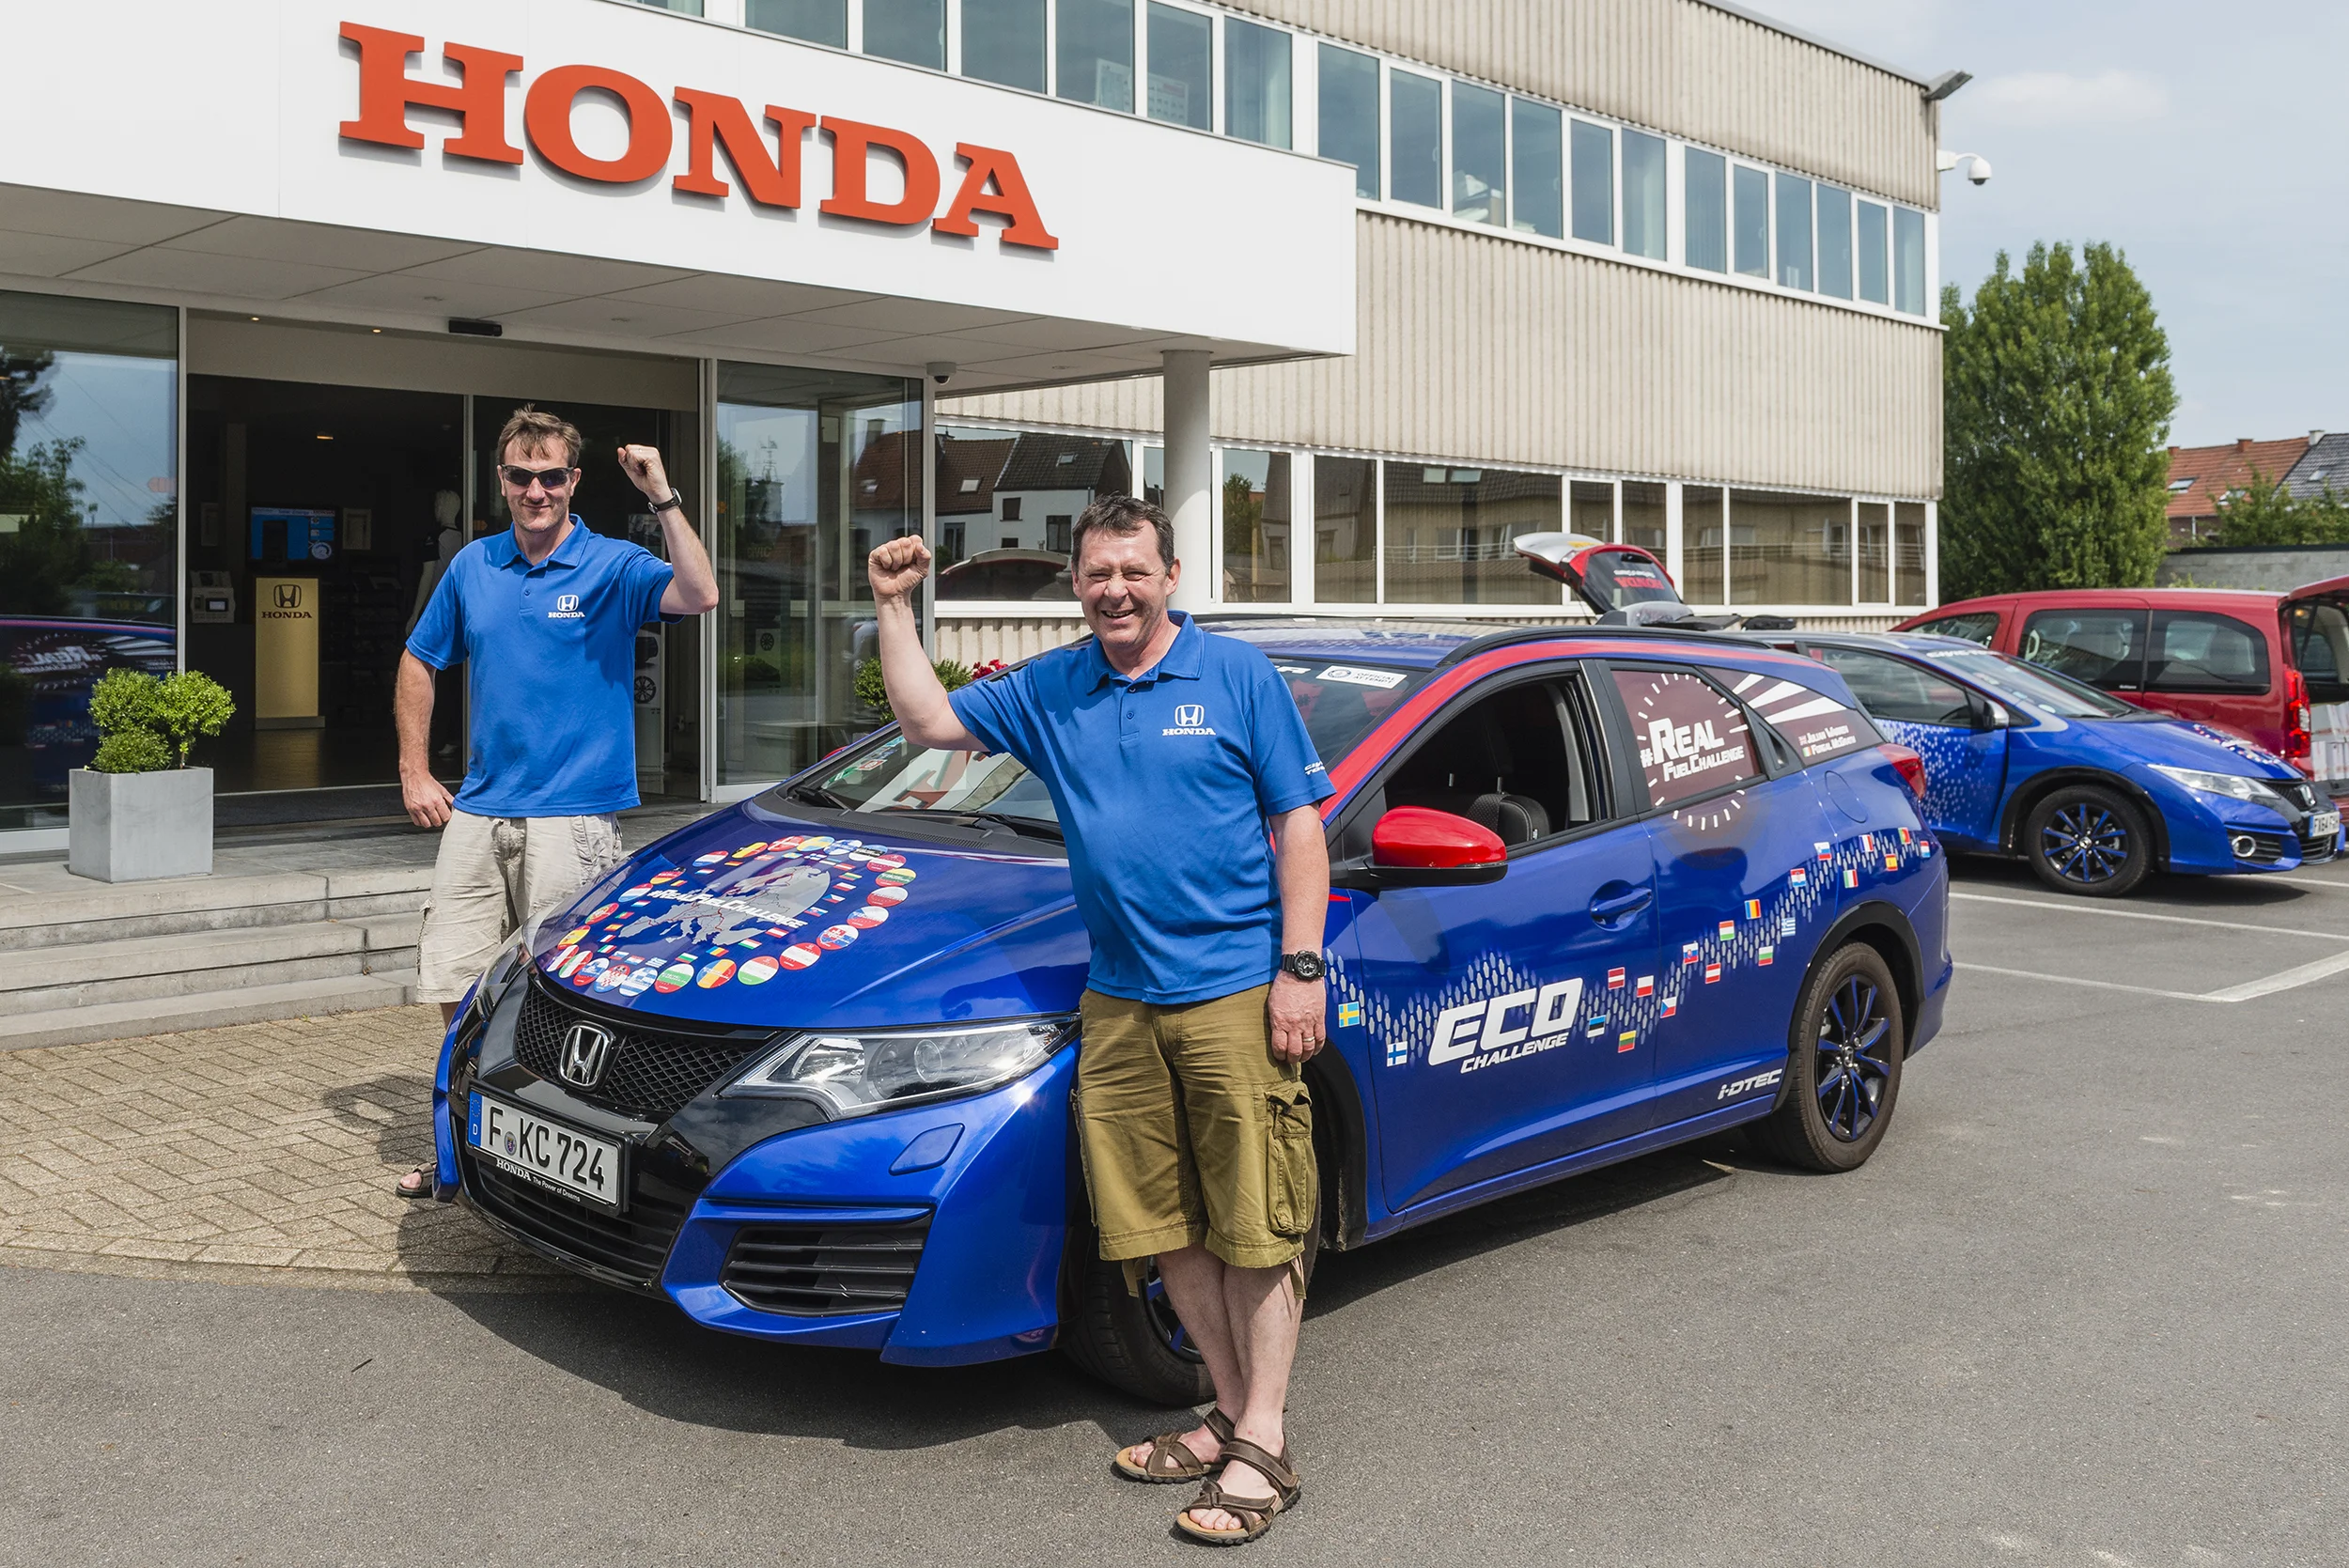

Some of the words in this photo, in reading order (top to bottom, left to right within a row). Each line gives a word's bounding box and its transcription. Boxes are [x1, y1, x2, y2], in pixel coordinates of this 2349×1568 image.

[339, 21, 1059, 251] HONDA
[1353, 675, 1394, 684] ATTEMPT
[1357, 672, 1396, 681] OFFICIAL
[1162, 727, 1216, 736] HONDA
[1427, 977, 1583, 1065] ECO
[1460, 1032, 1569, 1074] CHALLENGE
[1718, 1069, 1782, 1100] i-DTEC
[473, 1124, 478, 1136] D
[489, 1106, 504, 1146] F
[520, 1118, 551, 1168] KC
[557, 1132, 605, 1191] 724
[496, 1157, 532, 1182] HONDA
[533, 1176, 542, 1186] The
[542, 1180, 557, 1193] Power
[563, 1189, 581, 1203] Dreams
